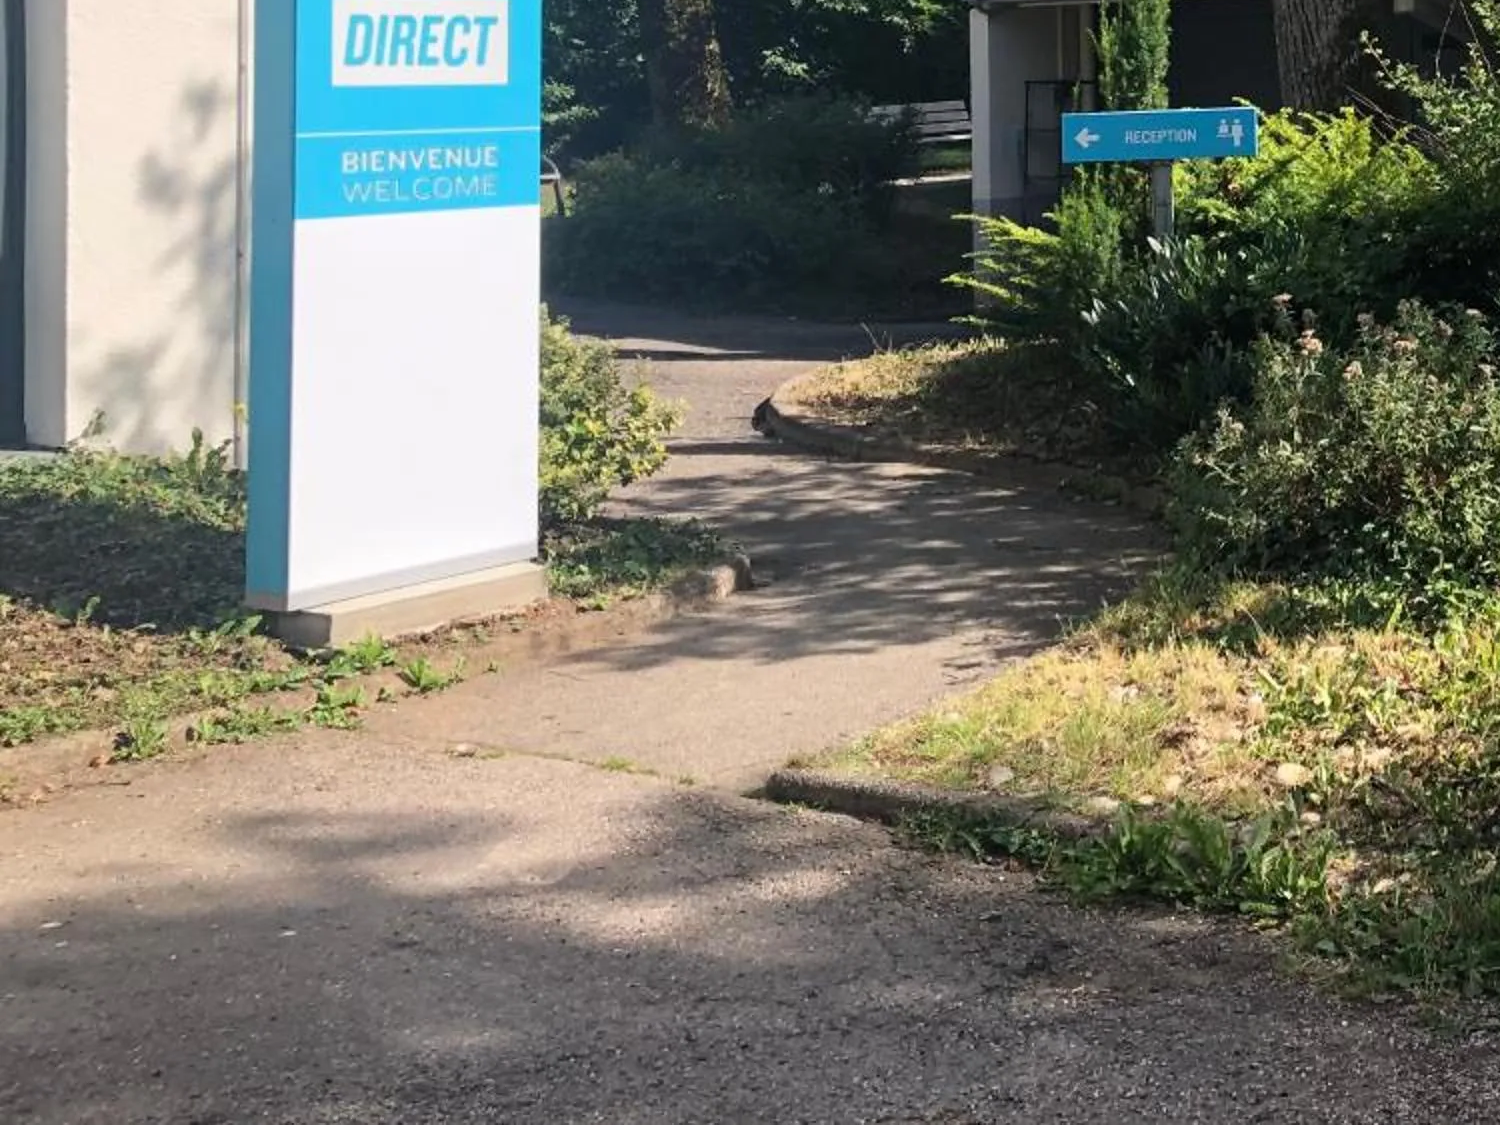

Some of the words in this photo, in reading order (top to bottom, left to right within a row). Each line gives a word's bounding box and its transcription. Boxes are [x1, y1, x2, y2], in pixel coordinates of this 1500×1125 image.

[343, 13, 499, 68] DIRECT
[1125, 128, 1197, 144] RECEPTION
[341, 145, 498, 174] BIENVENUE
[342, 174, 498, 203] WELCOME
